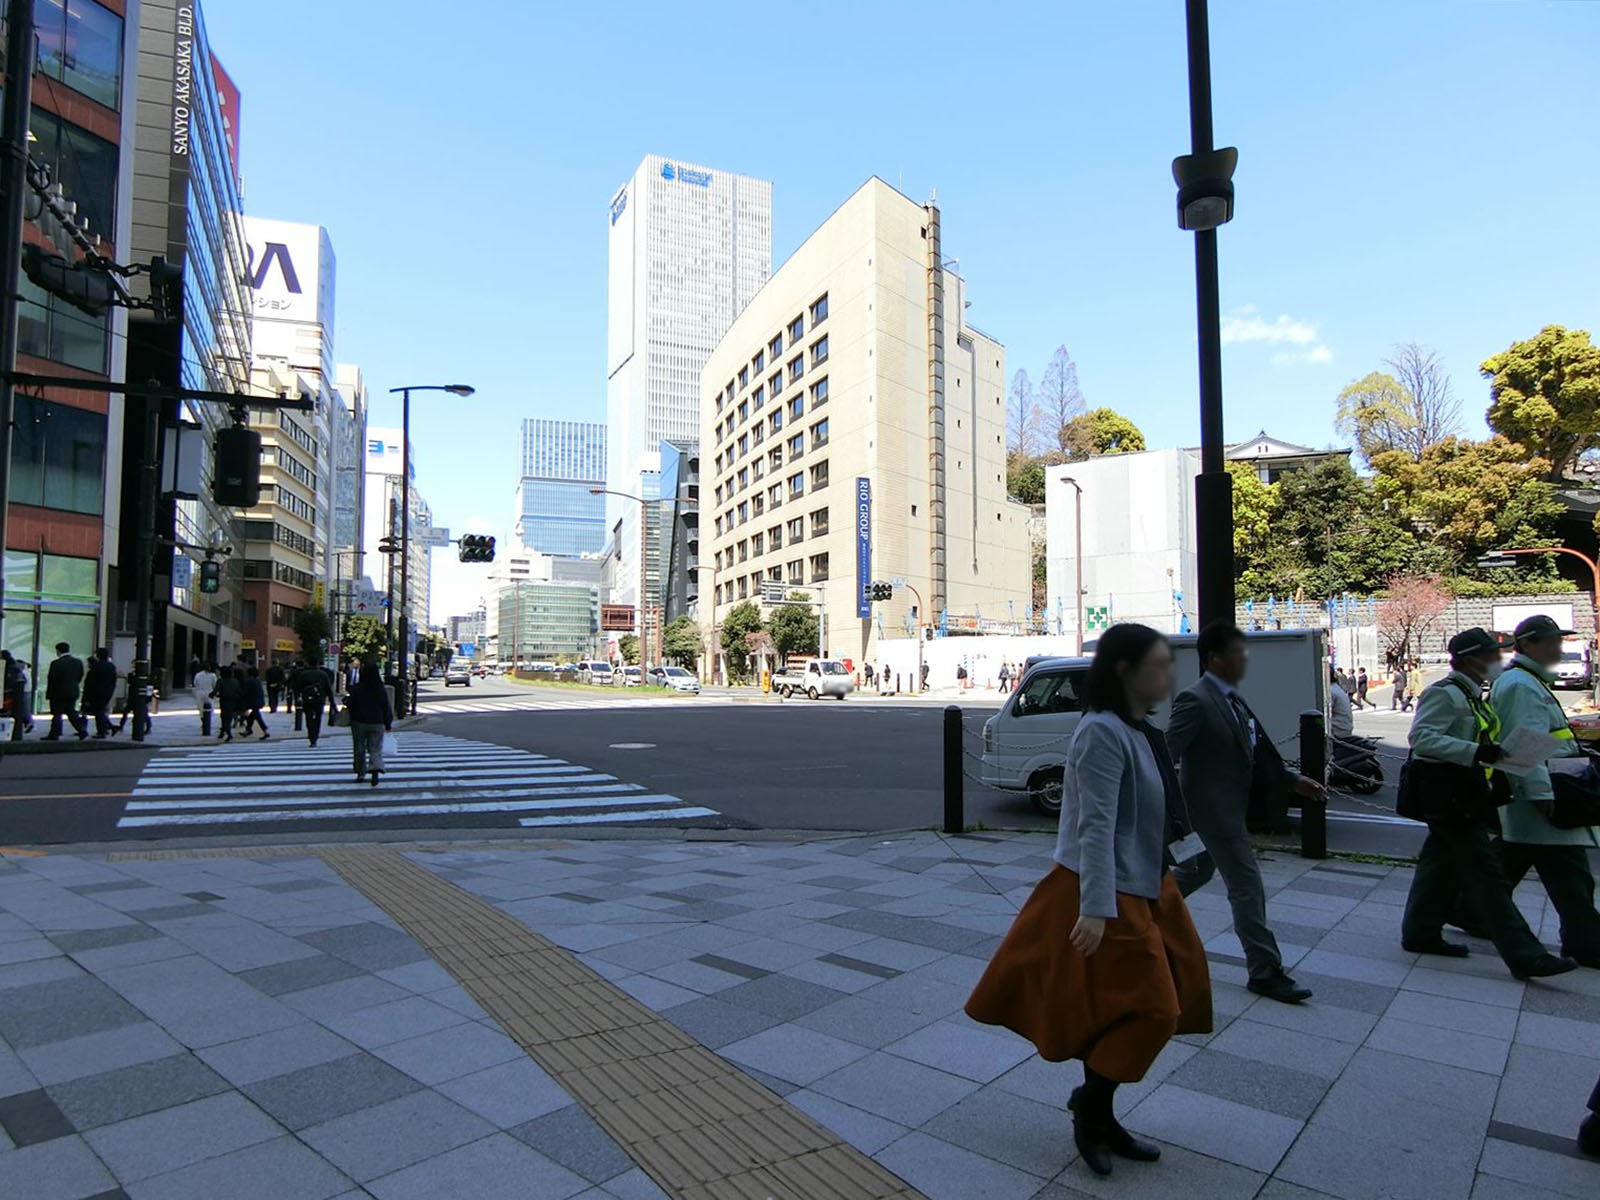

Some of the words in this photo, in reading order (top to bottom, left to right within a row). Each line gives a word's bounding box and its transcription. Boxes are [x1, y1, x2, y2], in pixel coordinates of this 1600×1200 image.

[177, 5, 193, 36] BLD.
[175, 41, 191, 104] AKASAKA
[173, 107, 189, 155] SANYO
[859, 481, 869, 501] RIO
[859, 503, 869, 540] GROUP
